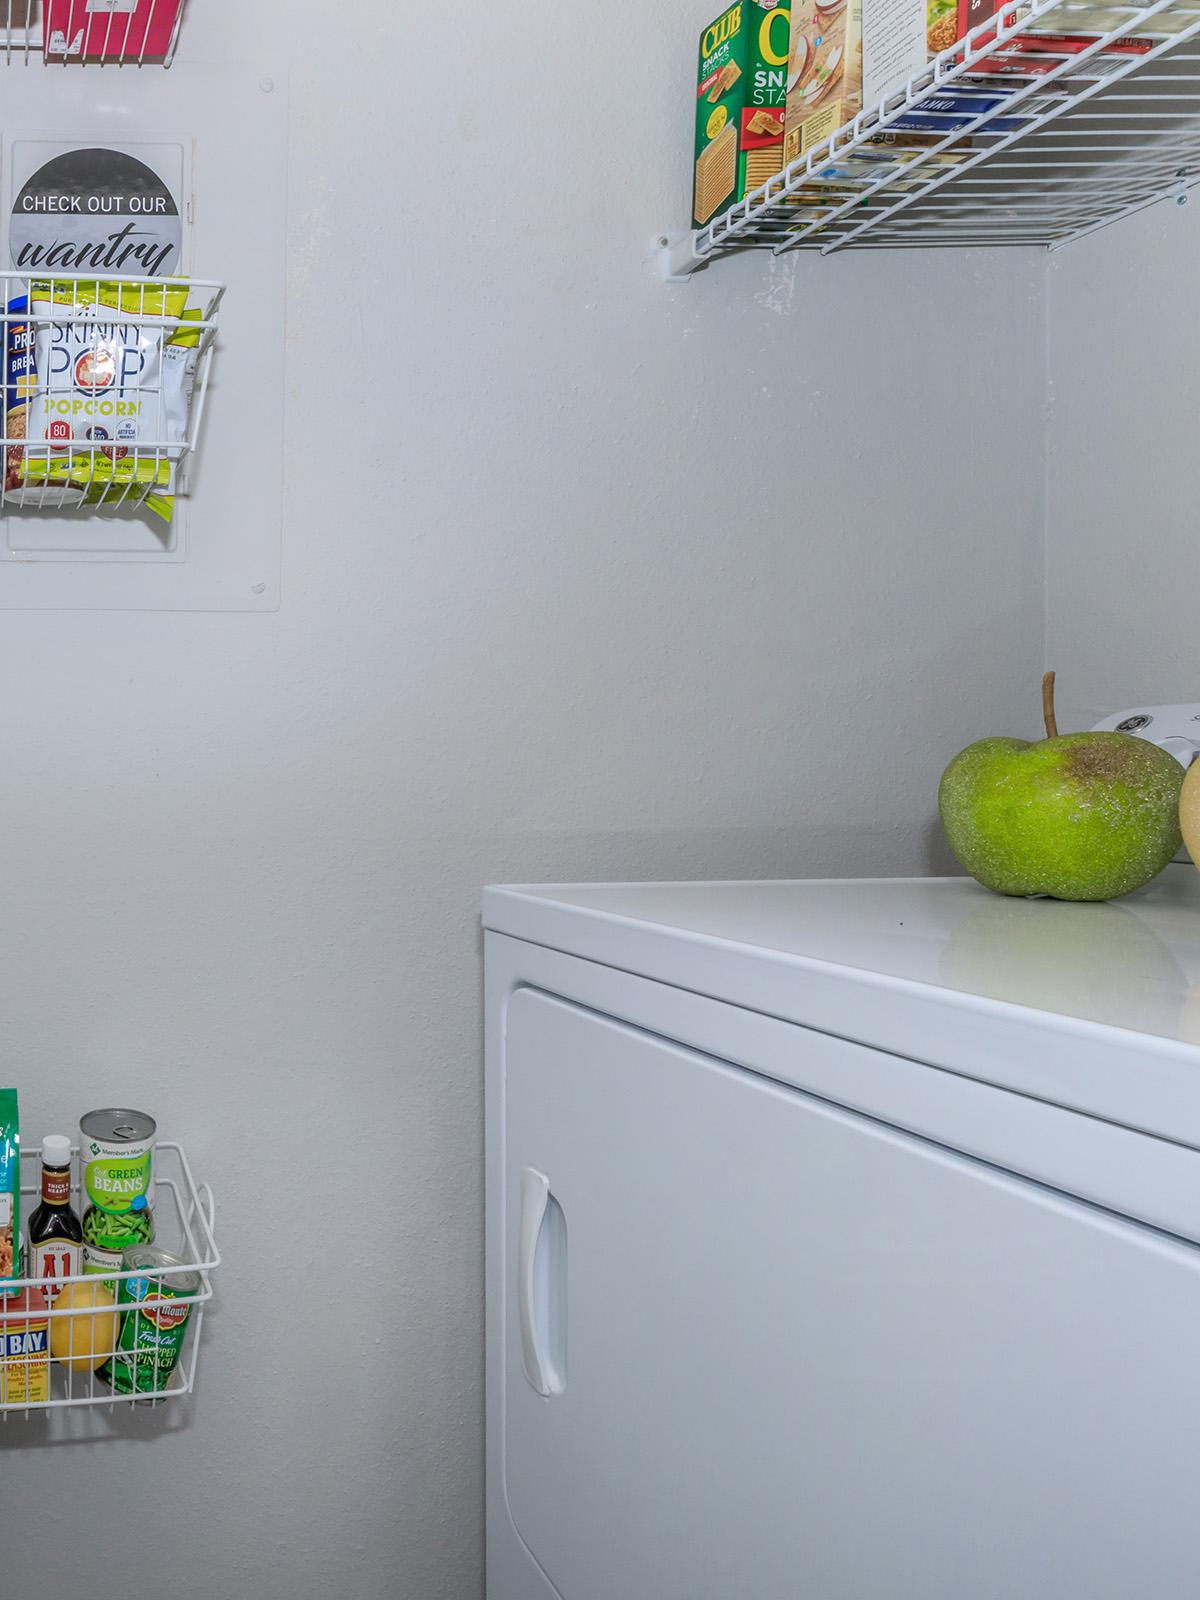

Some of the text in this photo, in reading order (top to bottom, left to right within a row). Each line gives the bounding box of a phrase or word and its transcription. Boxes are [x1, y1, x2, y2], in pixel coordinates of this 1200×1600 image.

[702, 5, 741, 58] CLUB
[703, 42, 729, 71] SNACK
[753, 89, 787, 104] STA
[917, 101, 955, 109] ANKO
[22, 195, 166, 212] CHECK OUT OUR
[17, 222, 175, 277] wantry
[14, 330, 36, 349] PRO
[12, 355, 35, 373] BREA
[47, 346, 145, 398] POP
[43, 399, 142, 416] POPCORN
[53, 424, 66, 437] 80
[108, 1168, 143, 1179] GREEN
[94, 1176, 144, 1193] BEANS
[162, 1305, 187, 1316] Monte
[10, 1332, 43, 1354] BAY
[1, 1352, 48, 1372] EASONING
[135, 1354, 174, 1368] PINACH
